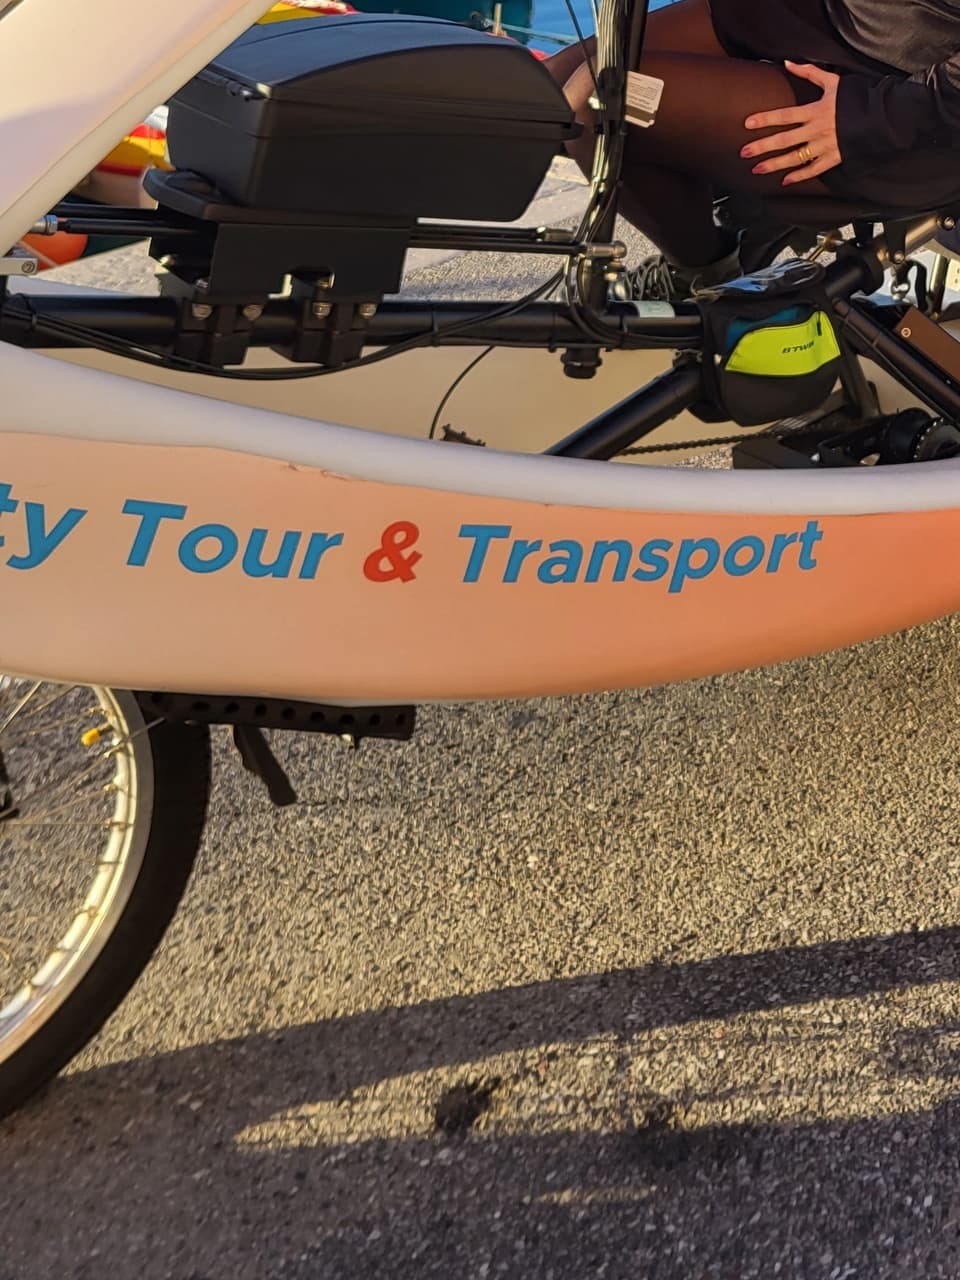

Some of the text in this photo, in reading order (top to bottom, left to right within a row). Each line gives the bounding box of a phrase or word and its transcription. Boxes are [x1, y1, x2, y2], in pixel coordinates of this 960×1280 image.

[122, 499, 345, 580] Tour
[362, 521, 423, 583] &
[458, 520, 824, 593] Transport
